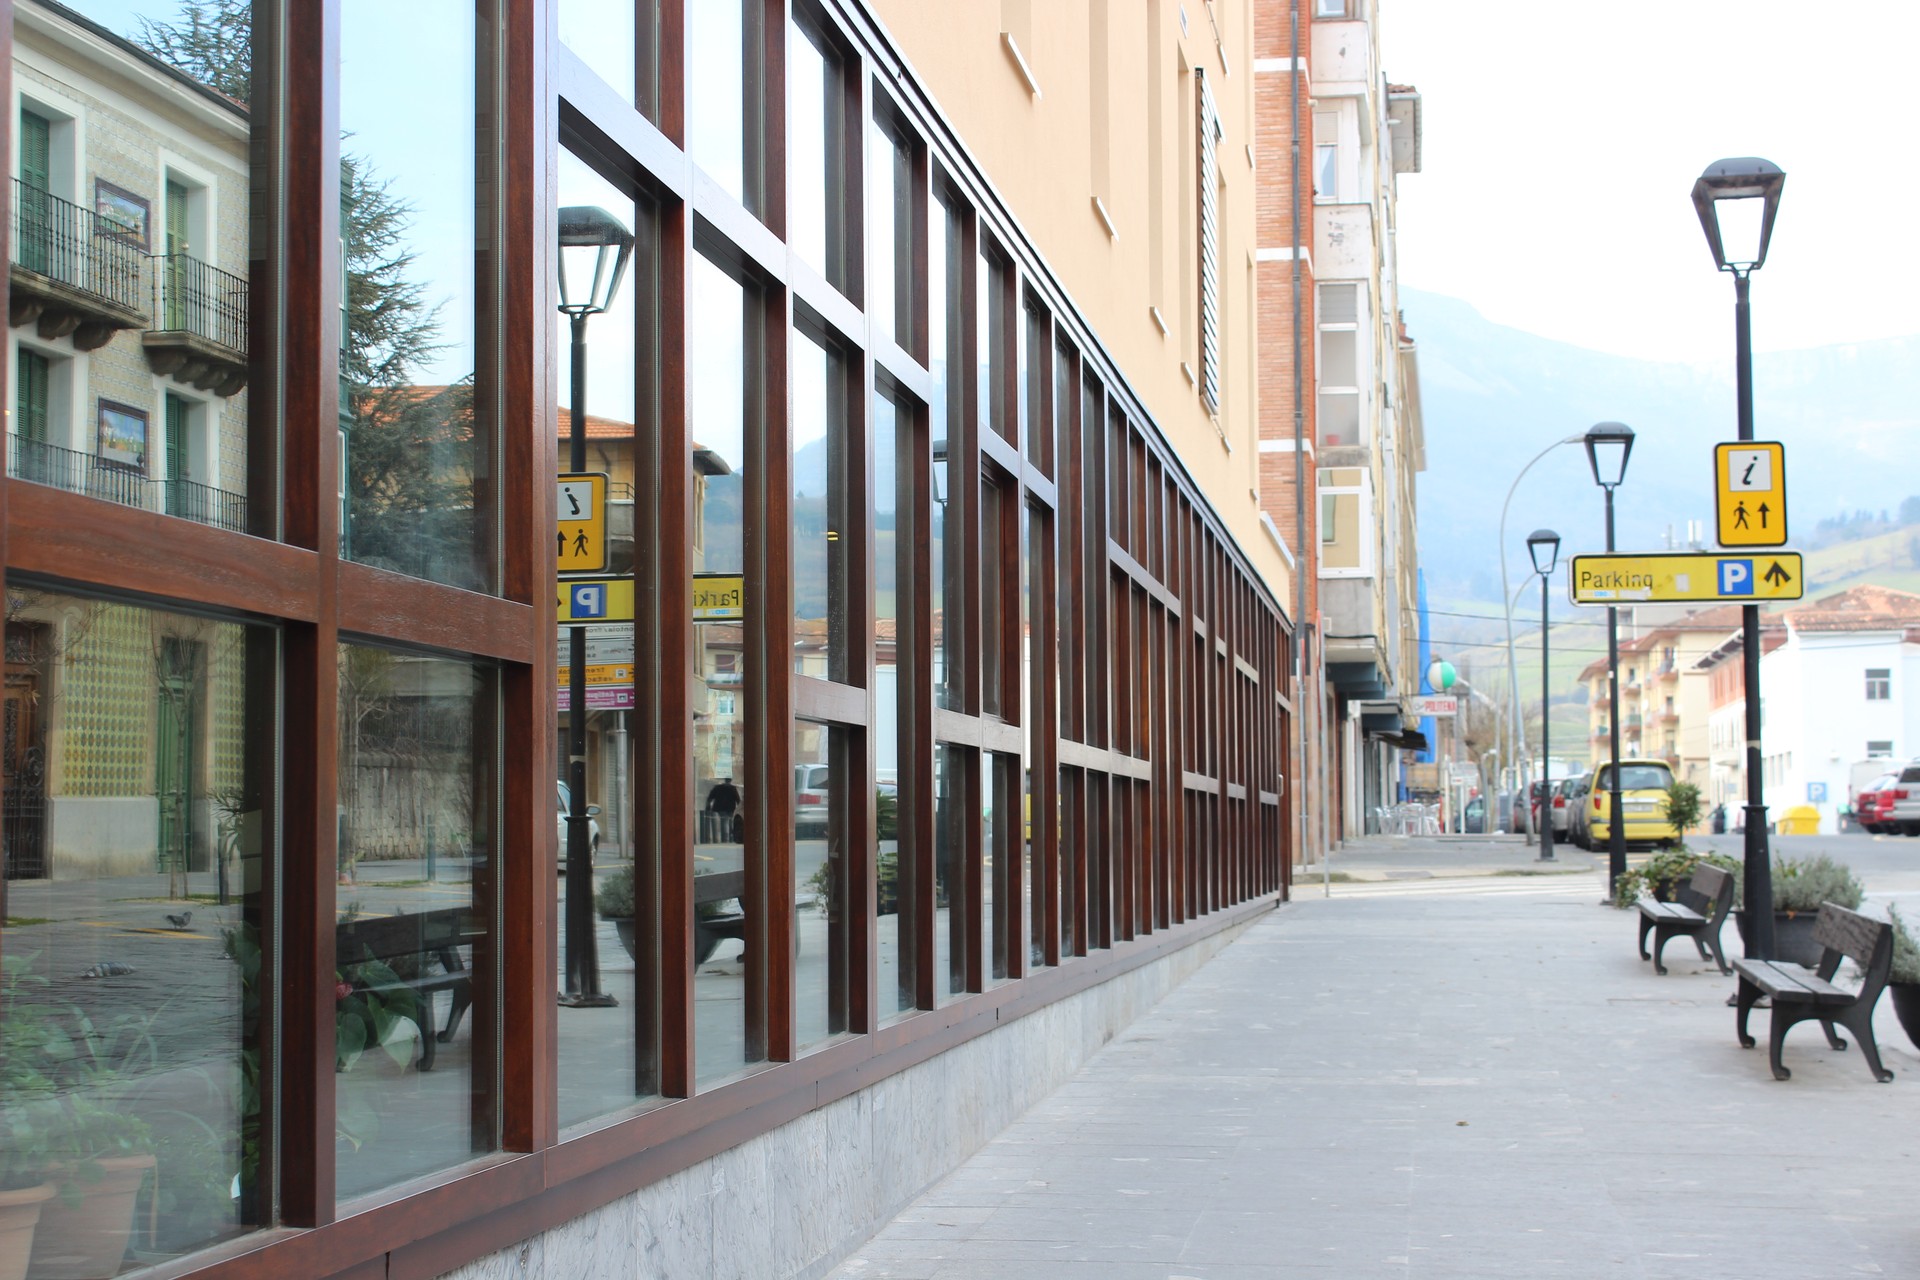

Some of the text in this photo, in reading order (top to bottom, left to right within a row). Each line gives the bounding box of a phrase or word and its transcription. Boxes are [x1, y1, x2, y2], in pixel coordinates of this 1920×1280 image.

[1581, 570, 1653, 589] Parking
[1723, 563, 1747, 592] P
[1812, 784, 1824, 799] P
